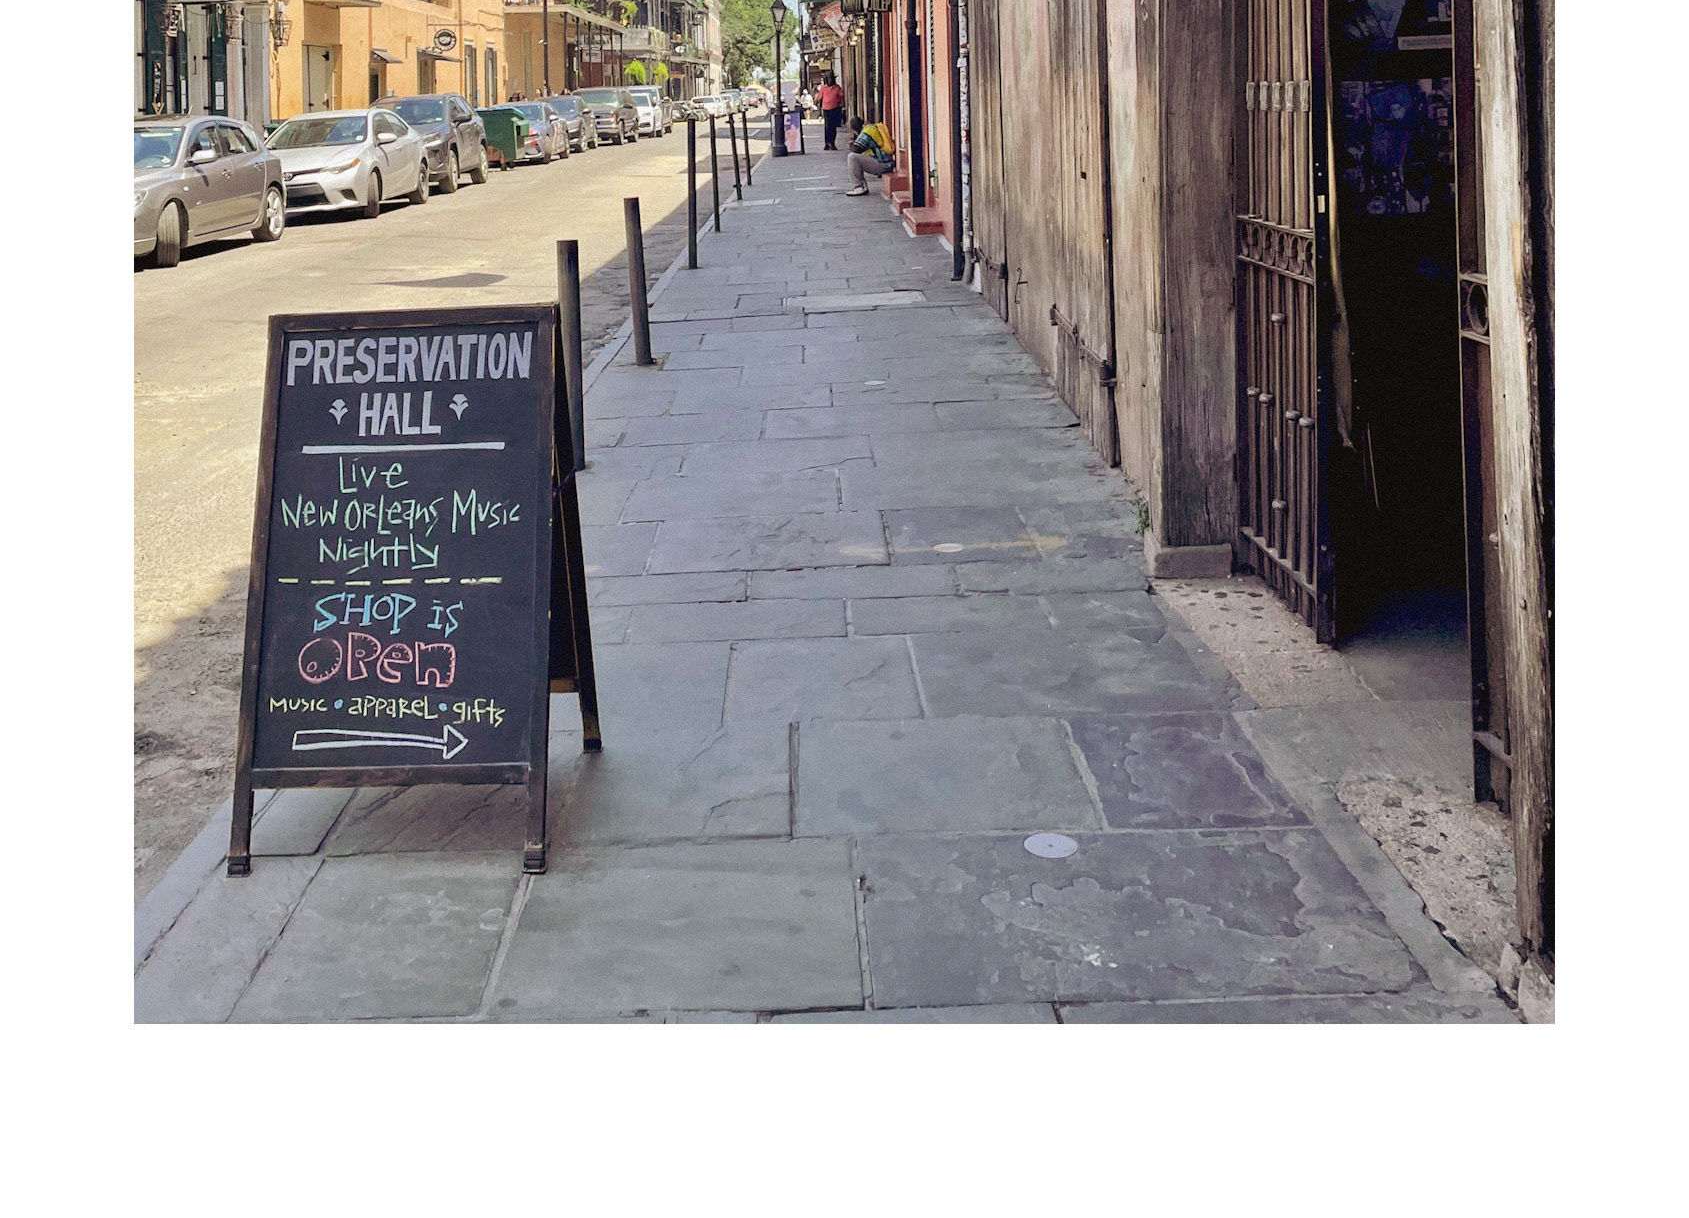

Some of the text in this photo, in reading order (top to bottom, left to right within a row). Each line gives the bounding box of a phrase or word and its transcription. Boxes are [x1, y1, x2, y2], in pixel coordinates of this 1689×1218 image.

[286, 332, 533, 386] PRESERVATION
[358, 390, 442, 437] HALL
[338, 456, 409, 494] Live
[281, 493, 338, 529] New
[451, 488, 520, 535] Music
[319, 533, 440, 575] Nightly
[314, 592, 417, 635] SHOP
[451, 697, 507, 728] gifts
